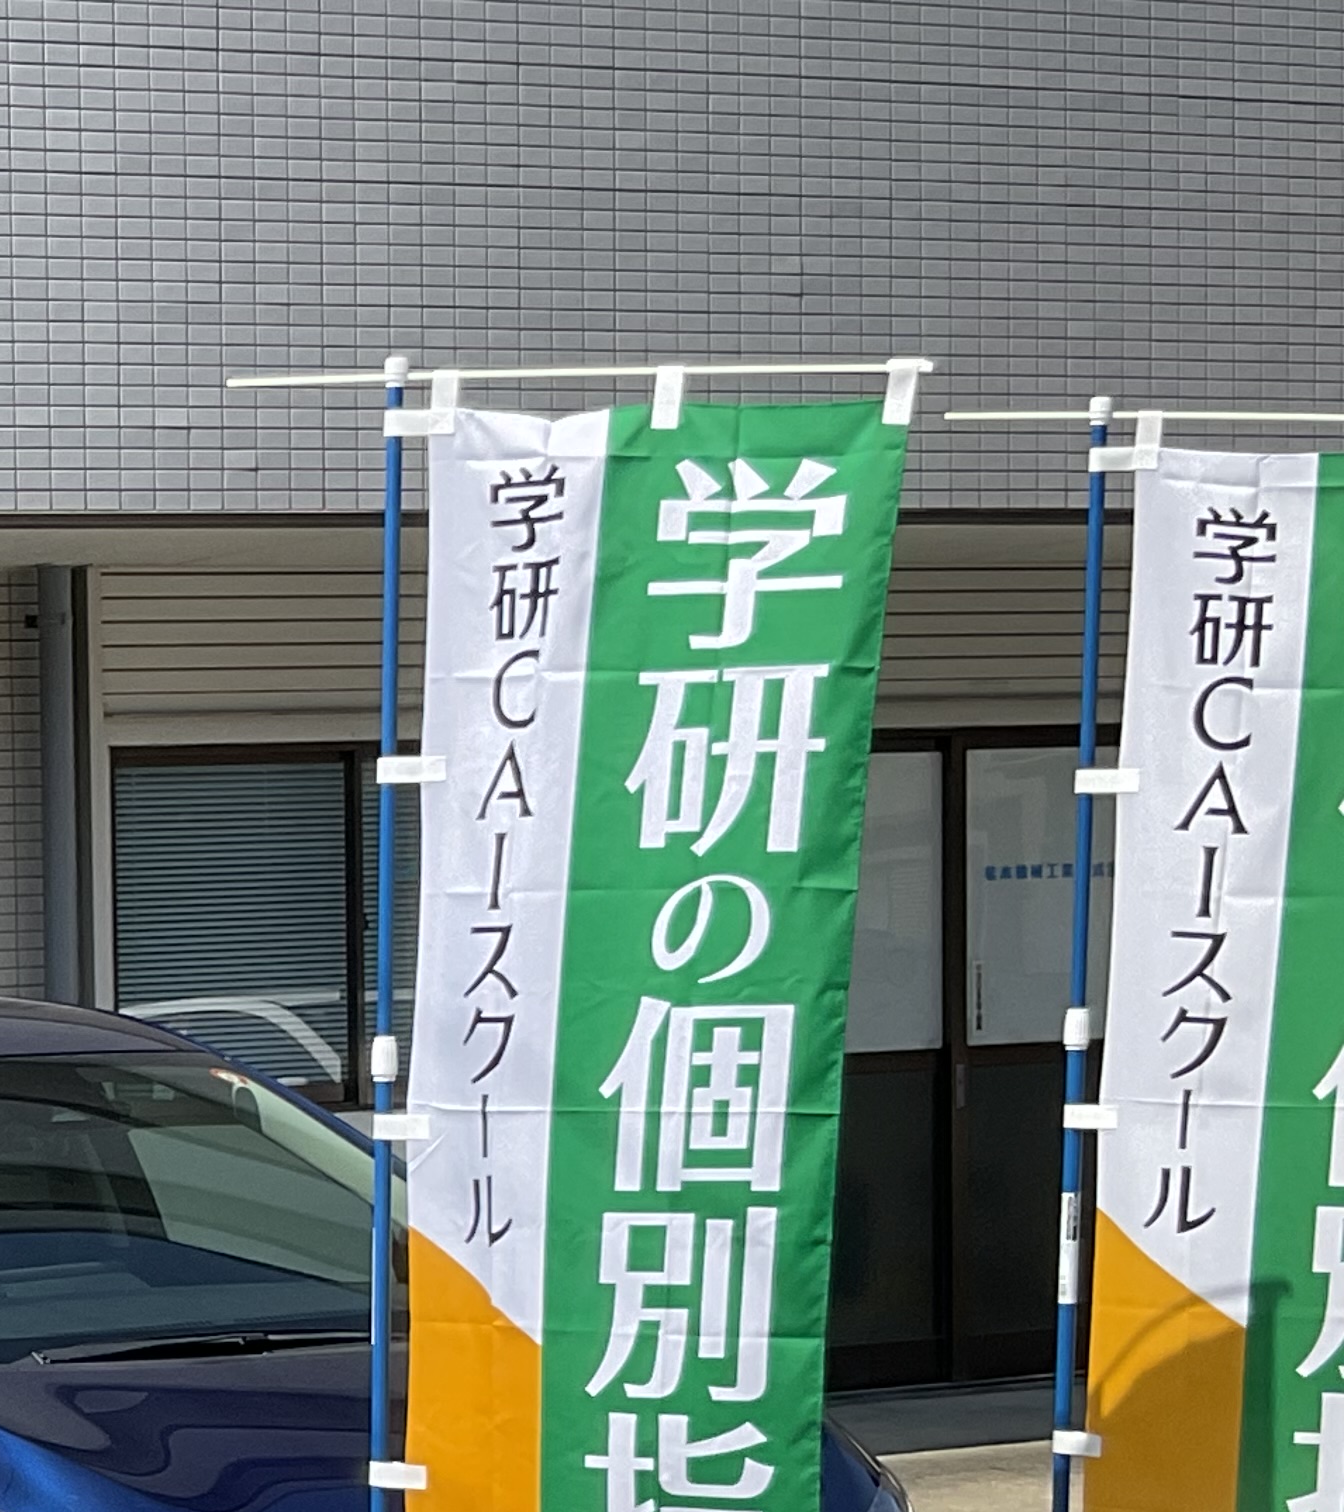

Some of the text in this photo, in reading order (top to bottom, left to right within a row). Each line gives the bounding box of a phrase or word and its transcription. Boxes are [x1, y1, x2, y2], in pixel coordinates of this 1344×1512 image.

[462, 465, 567, 1247] 学研CAIスクール
[1143, 507, 1277, 1235] 学研CAIスクール
